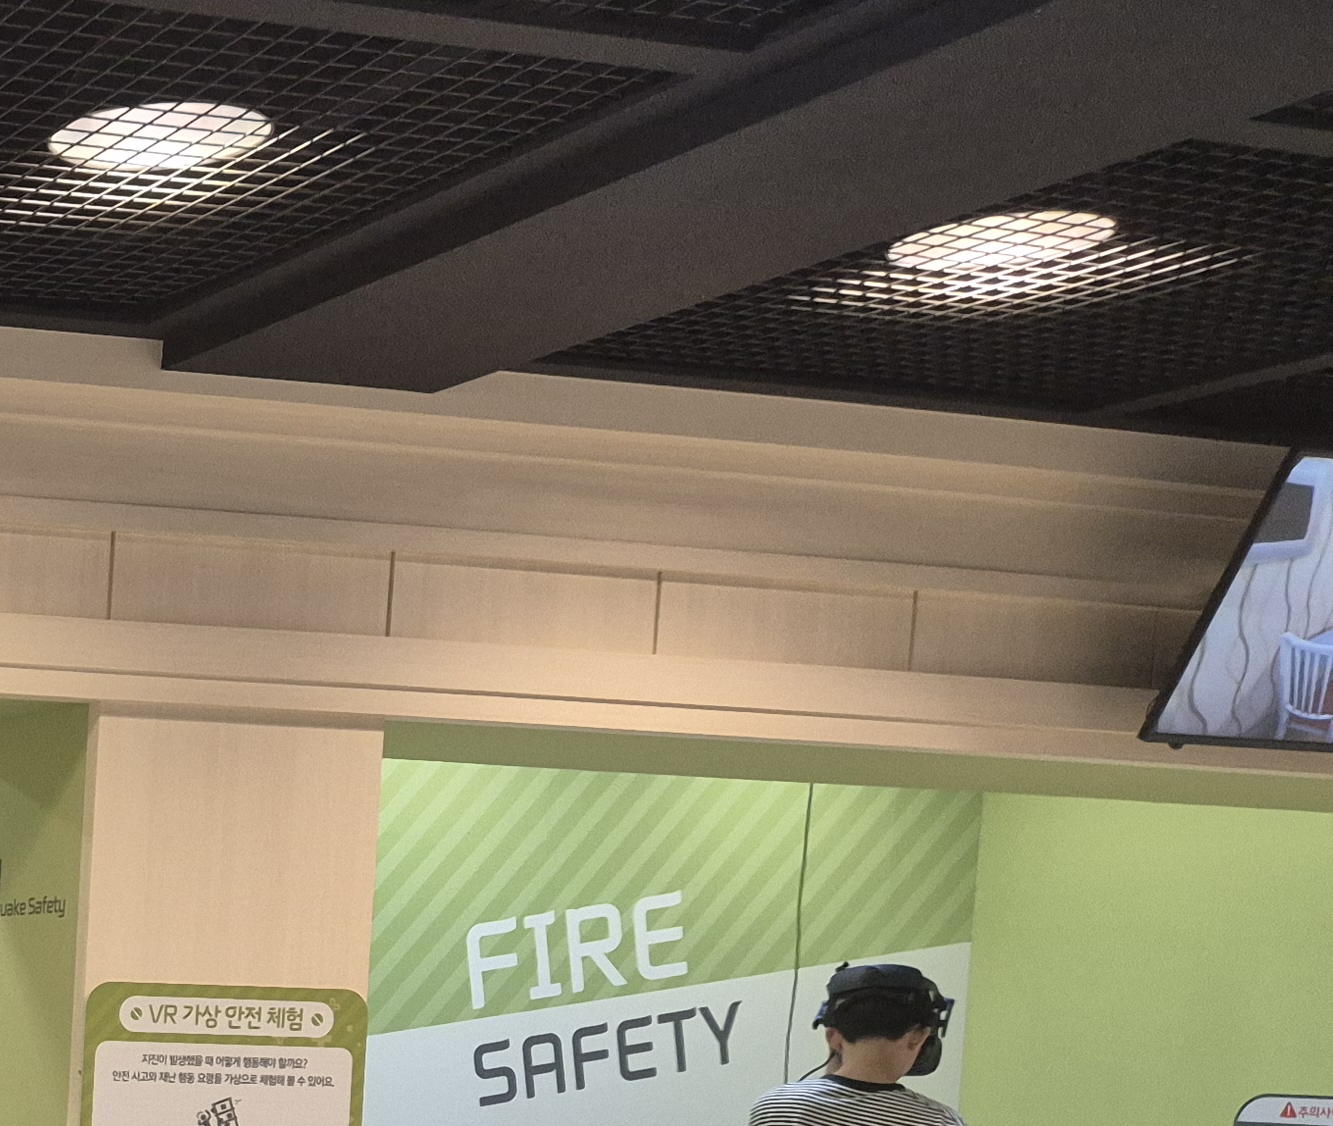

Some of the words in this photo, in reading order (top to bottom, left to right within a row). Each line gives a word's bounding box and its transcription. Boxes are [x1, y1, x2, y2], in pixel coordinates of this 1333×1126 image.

[28, 896, 66, 918] Safety
[466, 891, 688, 1009] FIRE
[149, 1004, 178, 1024] VR
[183, 1004, 221, 1029] 가상
[225, 1006, 262, 1030] 안전
[266, 1007, 304, 1031] 체험
[141, 1054, 168, 1066] 지진이
[205, 1056, 214, 1067] 때
[278, 1057, 308, 1070] 할까요?
[473, 1001, 742, 1106] SAFETY
[112, 1070, 130, 1082] 안전
[132, 1072, 157, 1083] 사고와
[224, 1074, 258, 1086] 가상으로
[297, 1075, 306, 1087] 수
